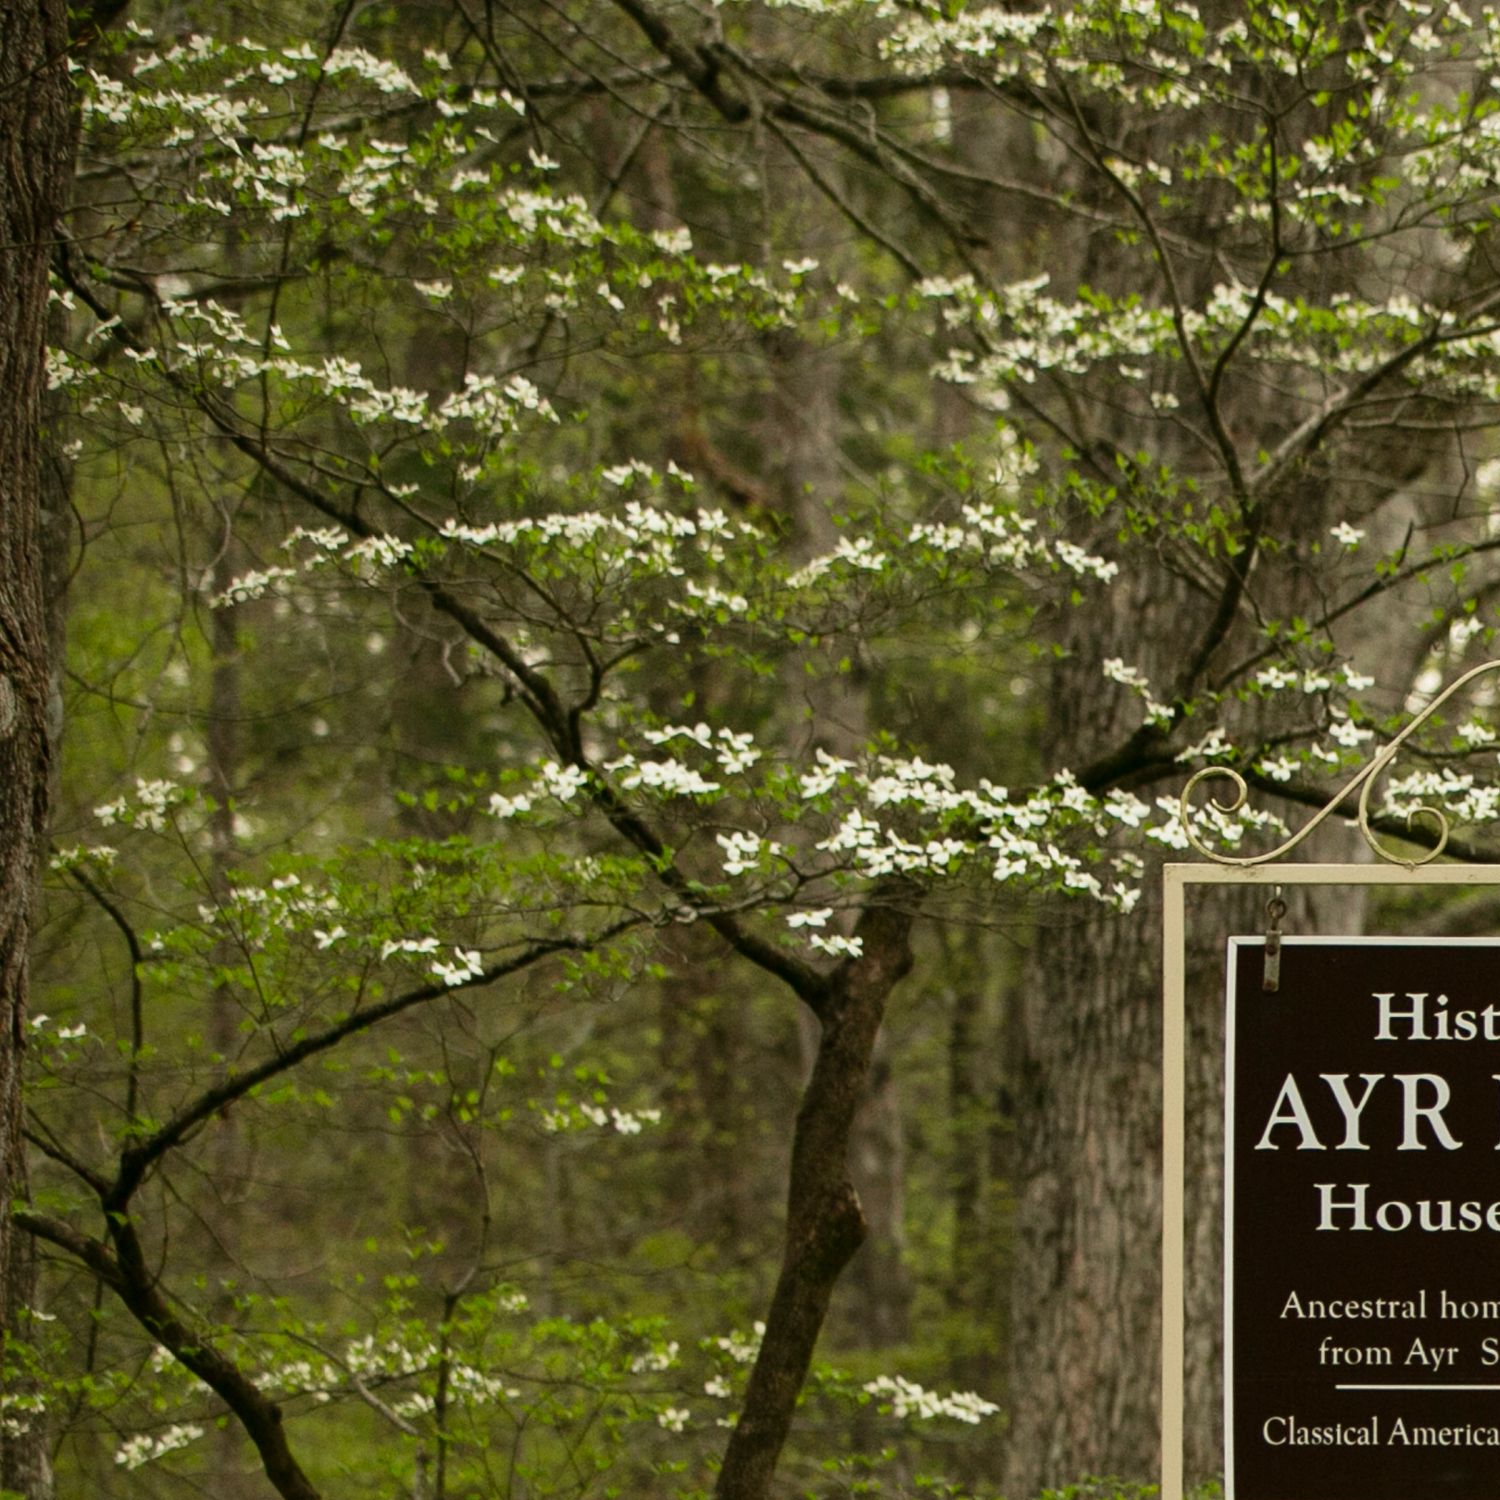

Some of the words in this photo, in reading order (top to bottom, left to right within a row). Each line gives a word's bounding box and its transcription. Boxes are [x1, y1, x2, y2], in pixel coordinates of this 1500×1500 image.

[1253, 1072, 1464, 1151] AYR
[1279, 1289, 1427, 1319] Ancestral
[1318, 1336, 1392, 1365] from
[1404, 1337, 1460, 1372] Ayr
[1262, 1415, 1379, 1446] Classical
